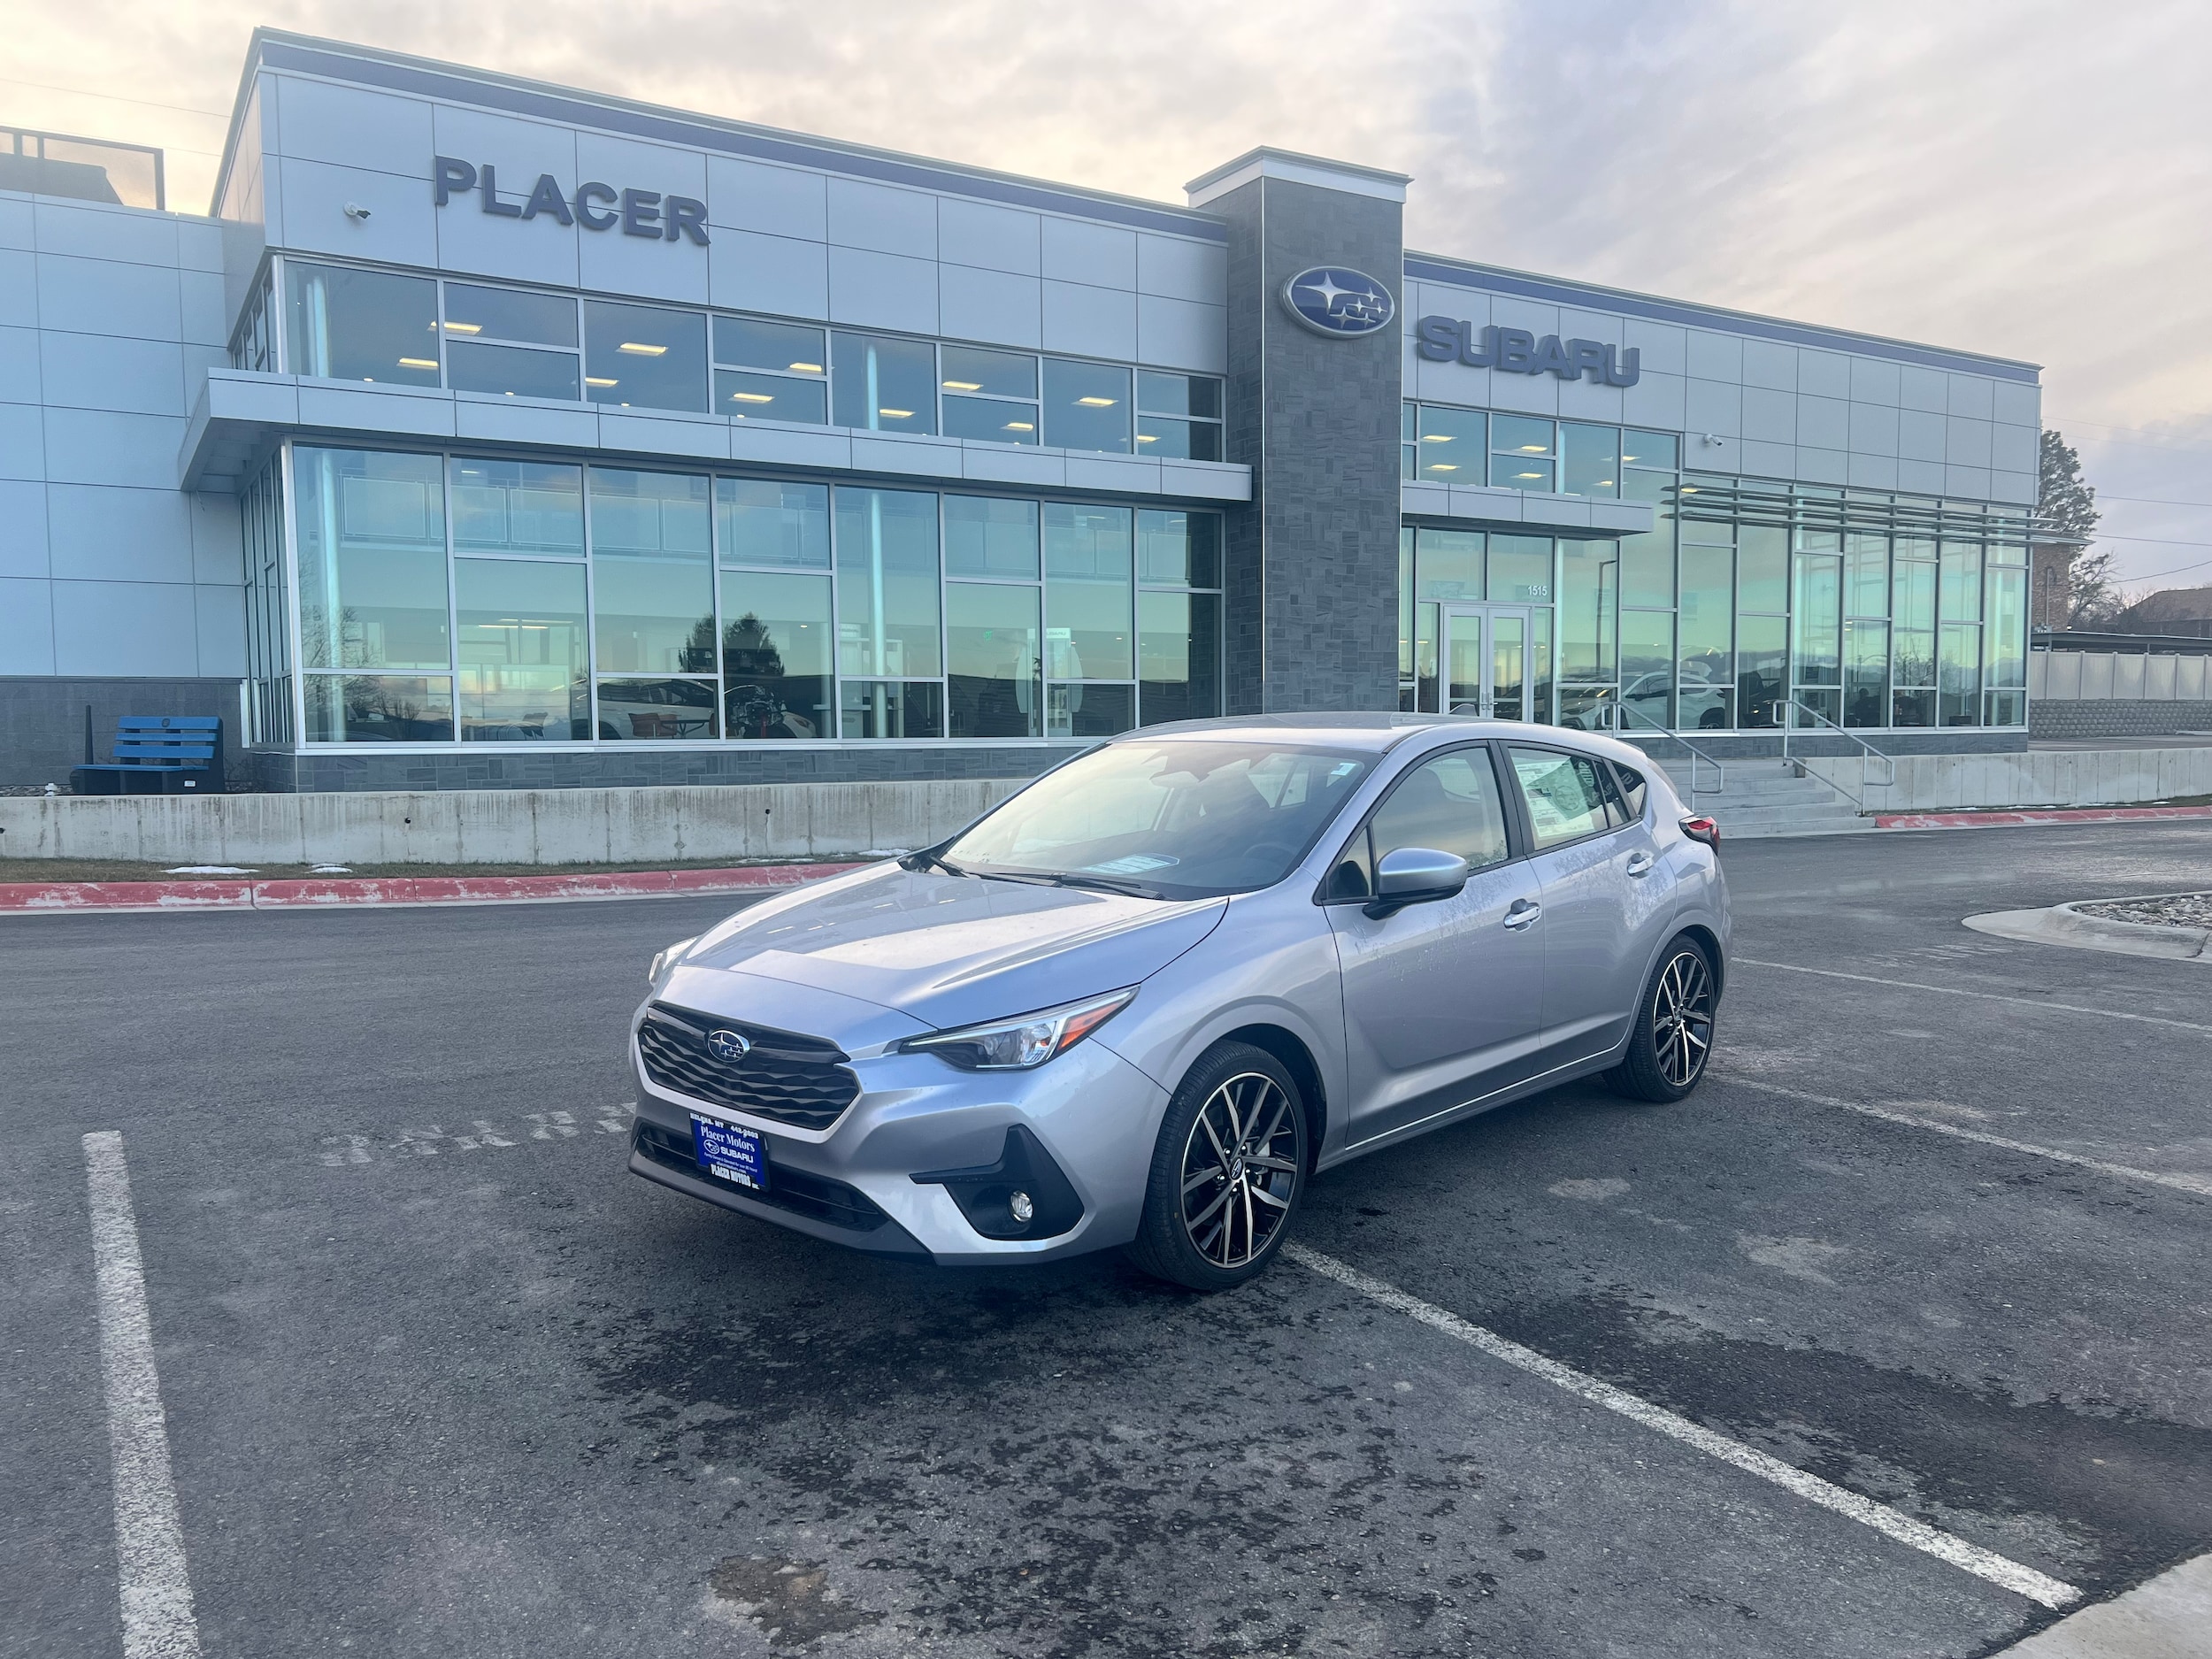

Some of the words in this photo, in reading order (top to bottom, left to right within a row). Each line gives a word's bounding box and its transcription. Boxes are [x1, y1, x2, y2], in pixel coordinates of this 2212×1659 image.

[433, 155, 710, 246] PLACER
[1417, 315, 1640, 387] SUBARU
[1527, 585, 1548, 596] 1515
[701, 1125, 726, 1143] Placer
[726, 1133, 756, 1153] Motors
[720, 1146, 754, 1164] SUBARU
[710, 1164, 730, 1180] PLACER
[730, 1170, 752, 1187] MOTORS
